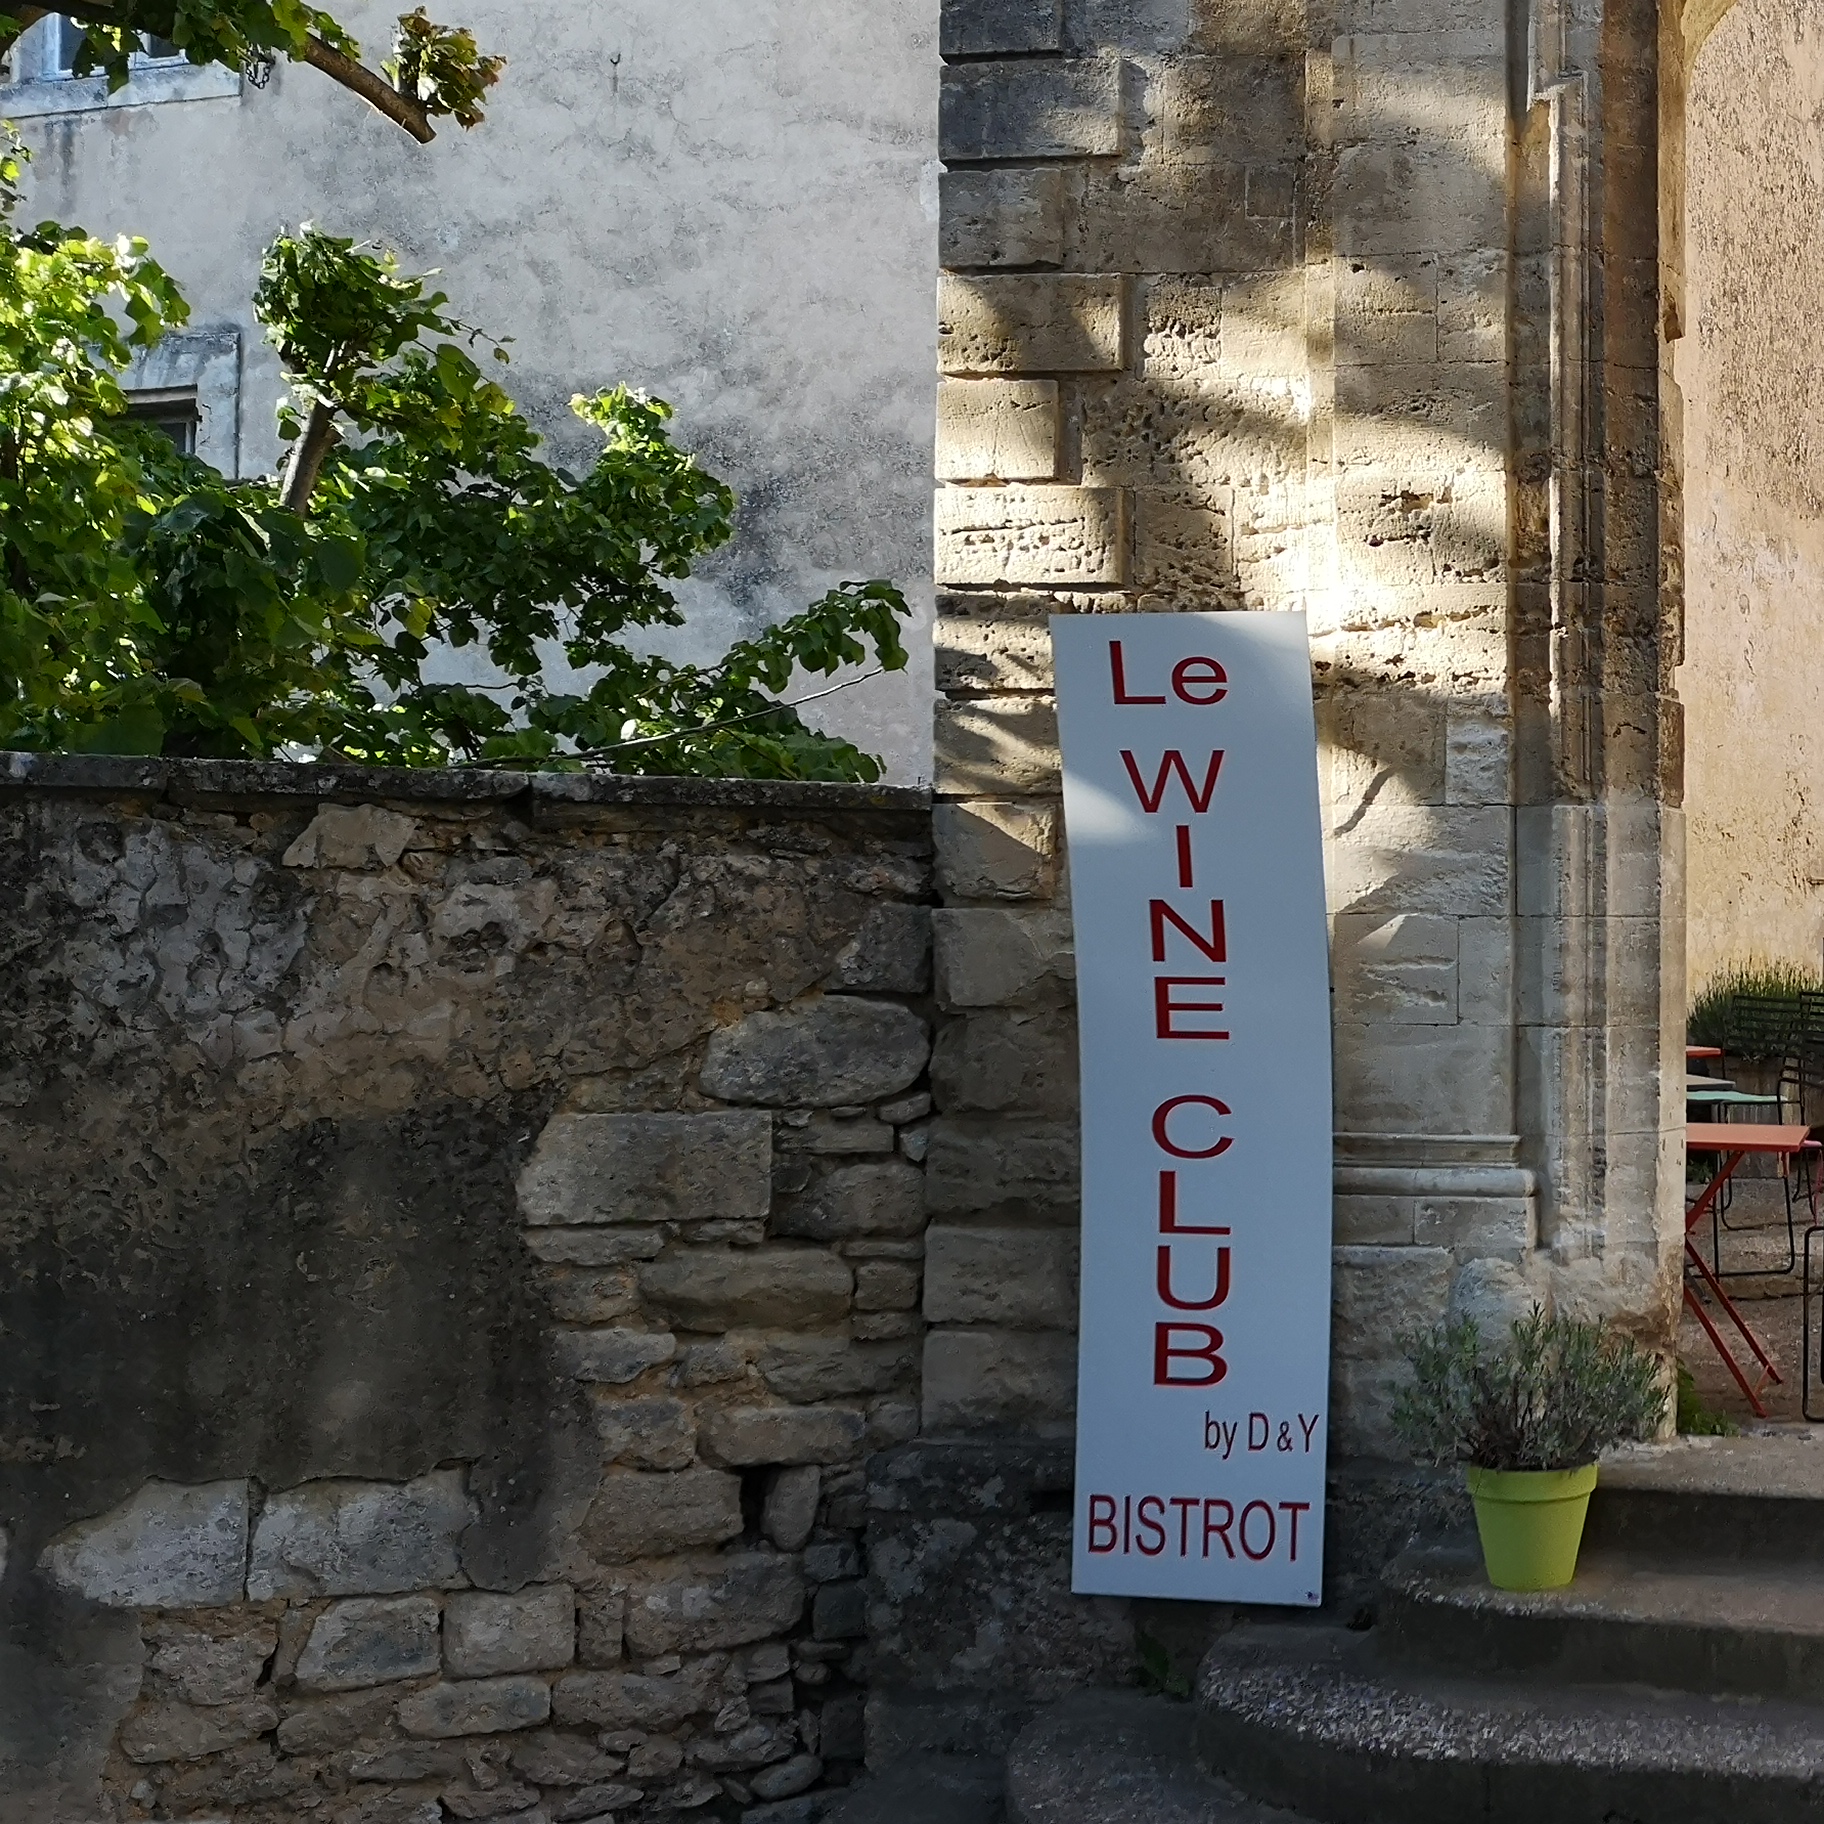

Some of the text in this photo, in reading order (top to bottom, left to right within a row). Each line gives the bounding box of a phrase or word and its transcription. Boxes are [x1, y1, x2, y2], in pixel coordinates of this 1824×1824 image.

[1109, 640, 1229, 706] Le
[1119, 749, 1231, 1042] WINE
[1151, 1093, 1235, 1388] CLUB
[1204, 1410, 1238, 1459] by
[1088, 1493, 1311, 1563] BISTROT
